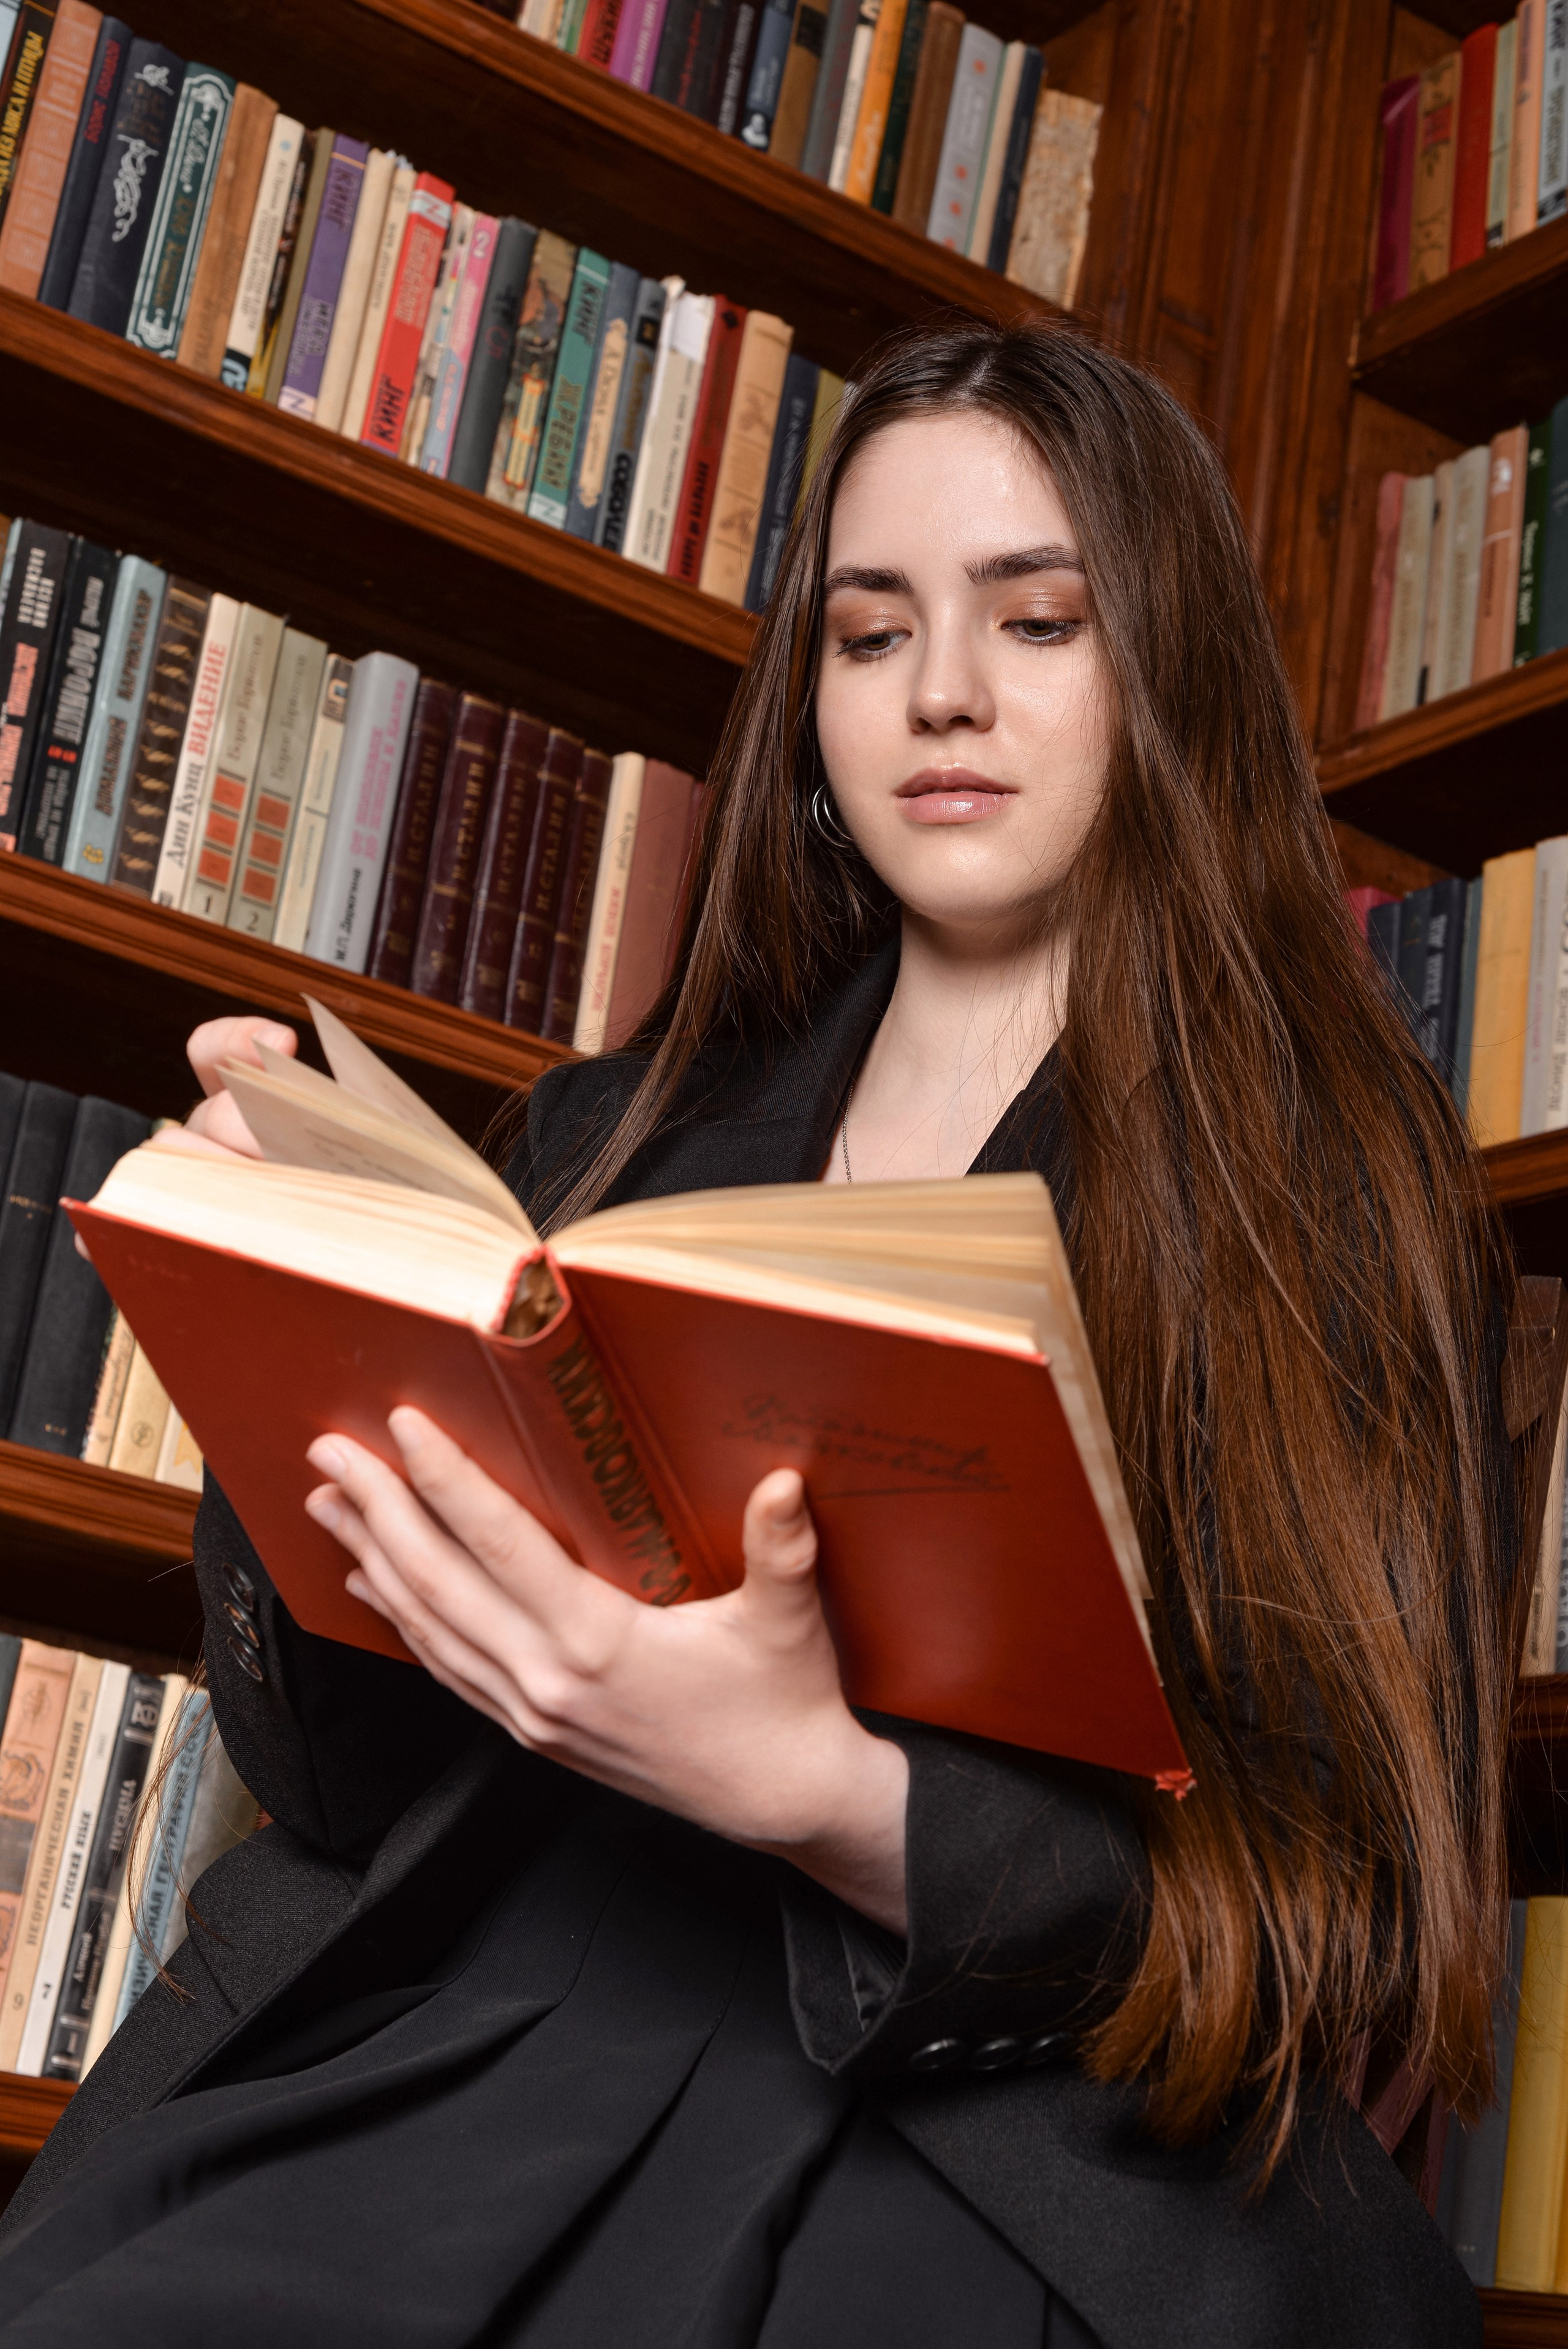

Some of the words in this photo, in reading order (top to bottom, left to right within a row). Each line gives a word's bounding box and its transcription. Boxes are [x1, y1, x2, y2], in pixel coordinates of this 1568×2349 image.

[325, 168, 355, 228] КИНГ
[571, 279, 601, 347] КИНГ
[373, 376, 404, 443] КИНГ
[187, 641, 228, 756] ВИДЕНИЕ
[178, 763, 204, 813] Кунц
[165, 813, 189, 868] Дин
[26, 1788, 70, 1946] НЕОРГАНИЧЕСКАЯ
[62, 1721, 84, 1781] ХИМИЯ
[61, 1852, 82, 1908] РУССКИЙ
[75, 1810, 92, 1849] ЯЗЫК
[42, 1983, 52, 2000] 7
